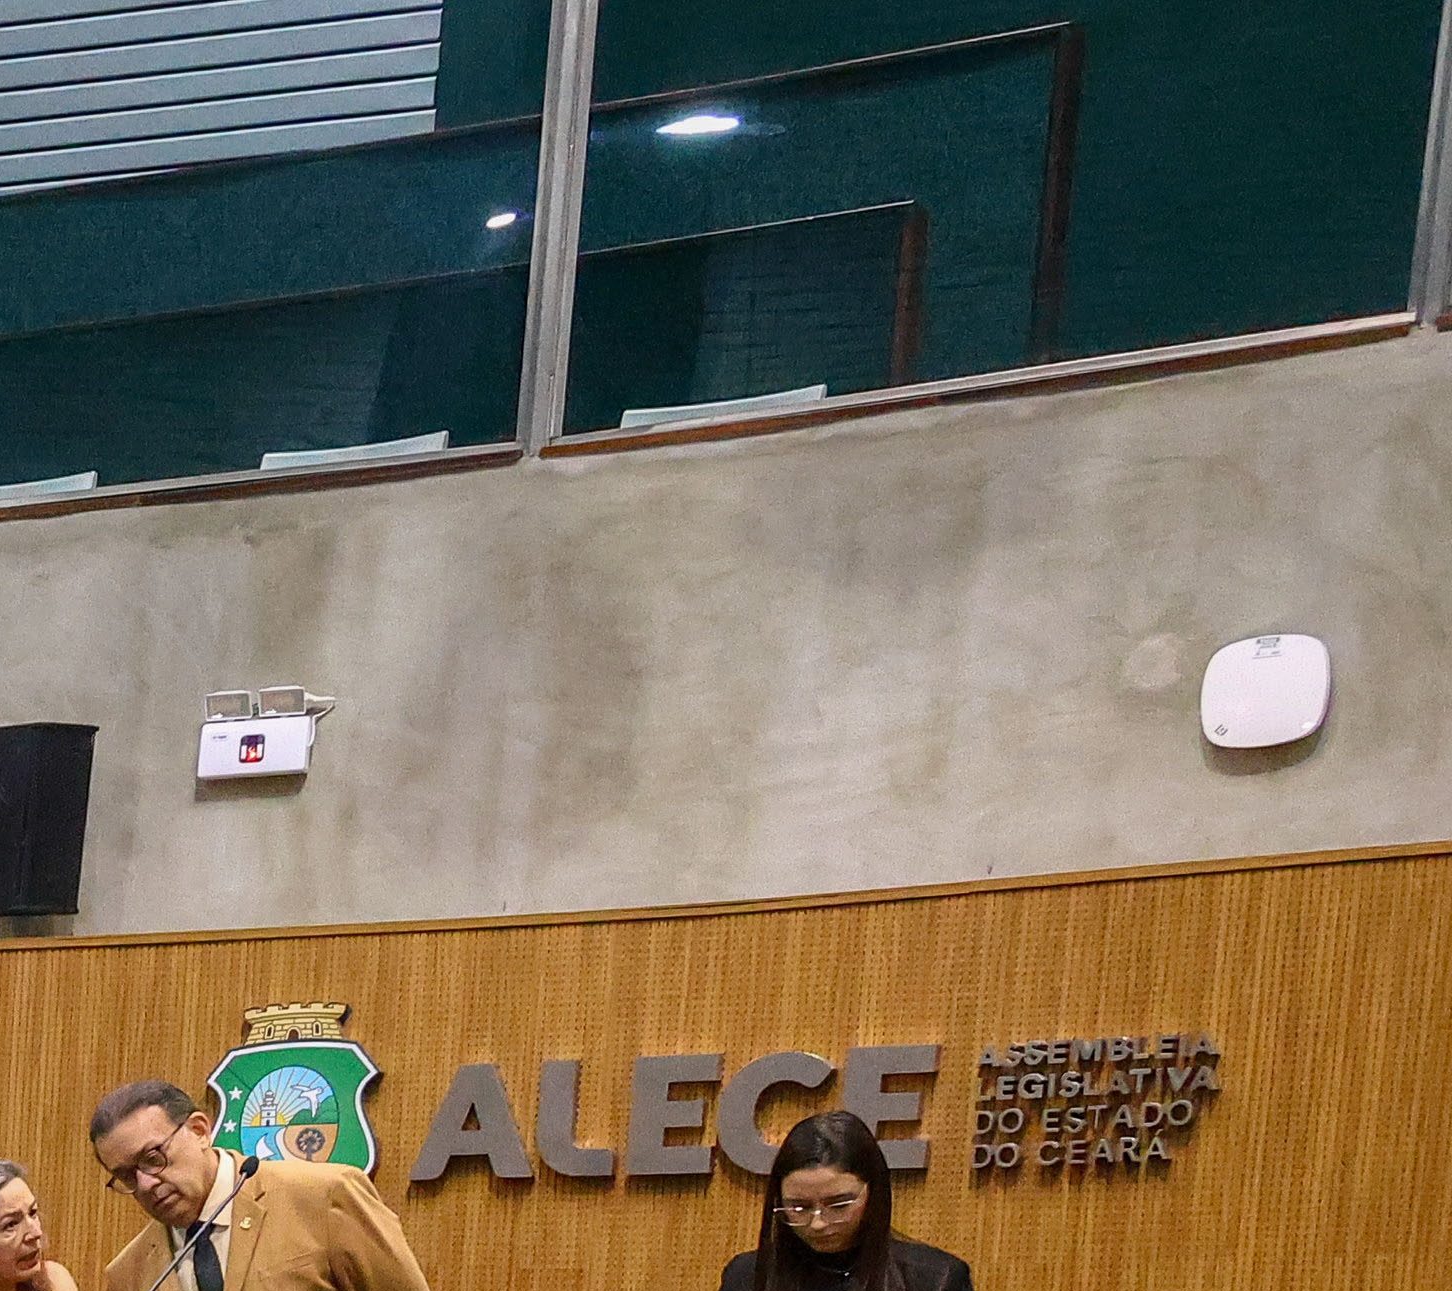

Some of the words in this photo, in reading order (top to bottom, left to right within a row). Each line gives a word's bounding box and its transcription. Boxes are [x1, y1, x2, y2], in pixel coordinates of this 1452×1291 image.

[978, 1034, 1220, 1067] ASSEMBLEIA
[978, 1066, 1221, 1100] LEGISLATIVA
[409, 1044, 941, 1181] ALECE
[976, 1108, 1024, 1134] DO
[1041, 1100, 1193, 1133] ESTADO
[972, 1142, 1020, 1169] DO
[1038, 1128, 1170, 1166] CEARÁ
